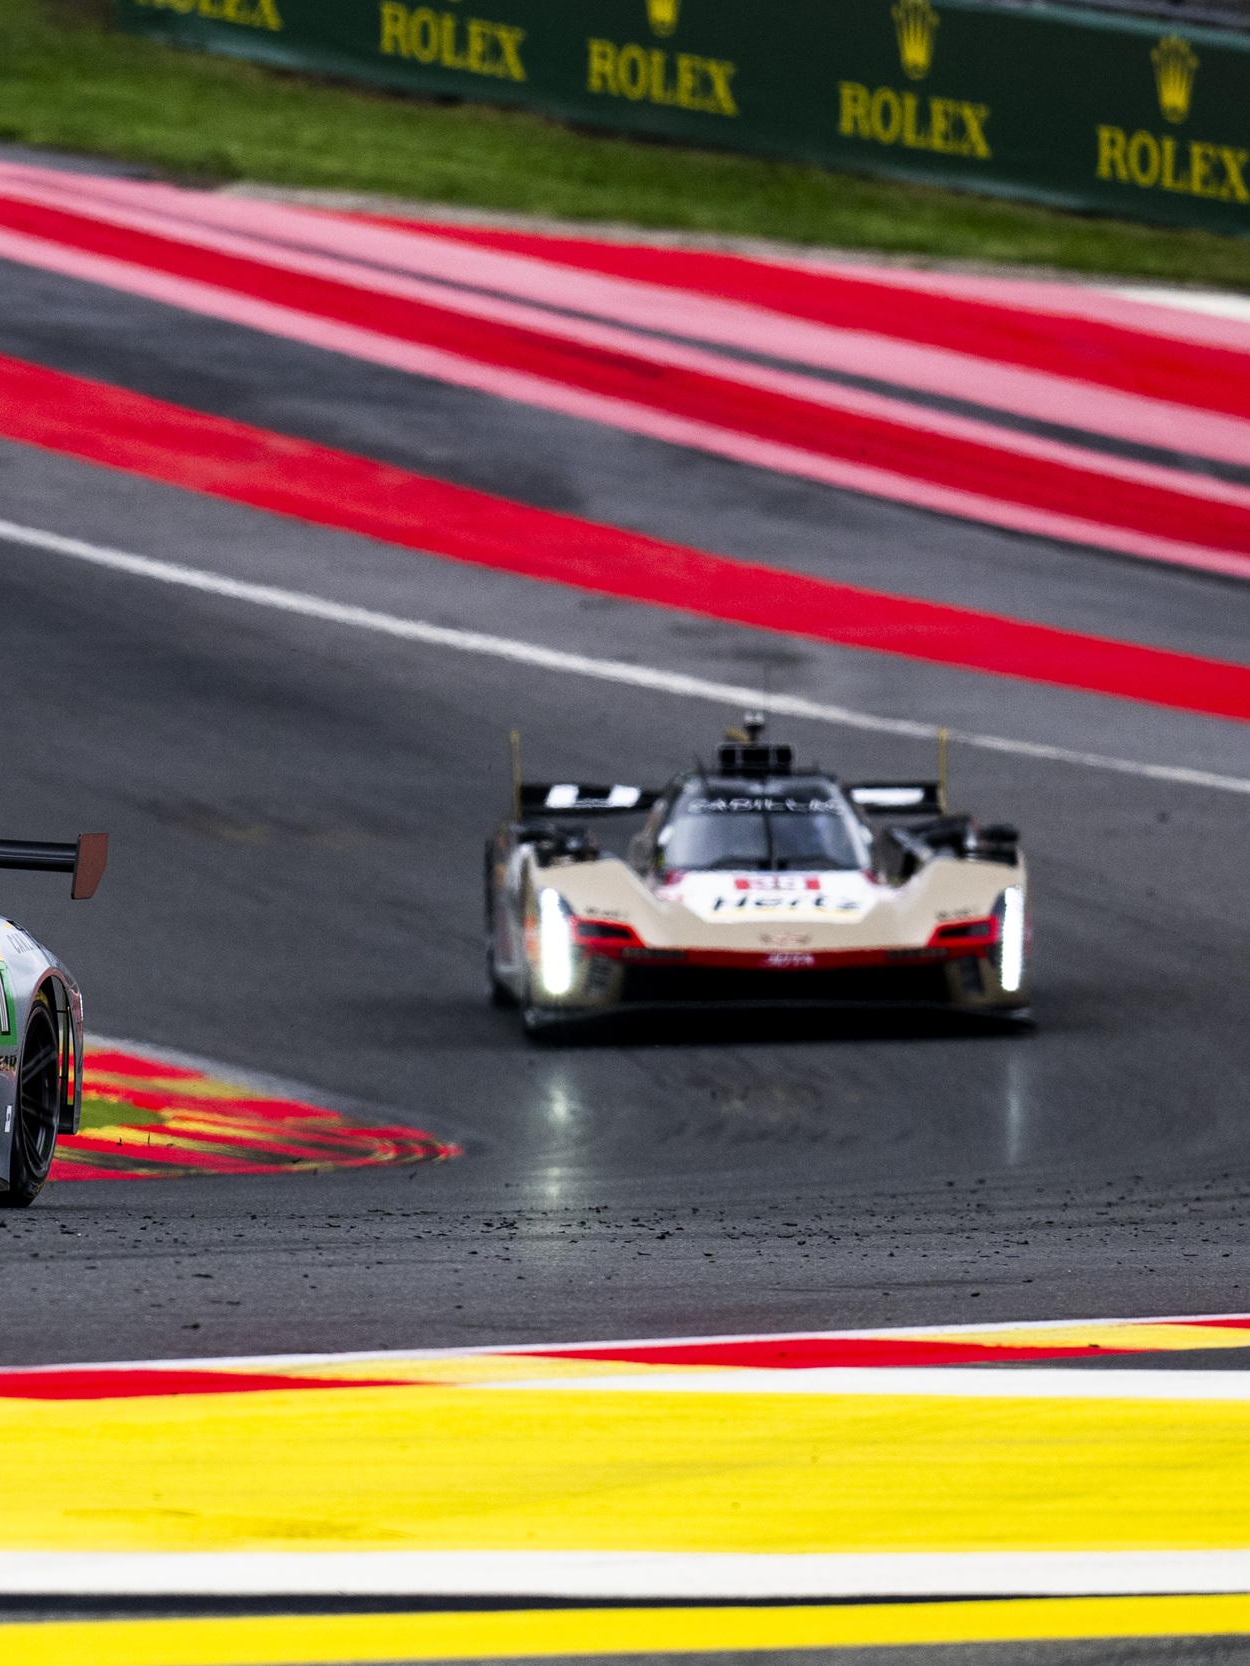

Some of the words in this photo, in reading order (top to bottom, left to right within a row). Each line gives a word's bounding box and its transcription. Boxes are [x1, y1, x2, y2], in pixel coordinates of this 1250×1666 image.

[379, 1, 527, 82] ROLEX
[587, 38, 739, 117] ROLEX
[837, 80, 991, 159] ROLEX
[1096, 124, 1250, 204] ROLEX
[711, 892, 863, 912] Hertz
